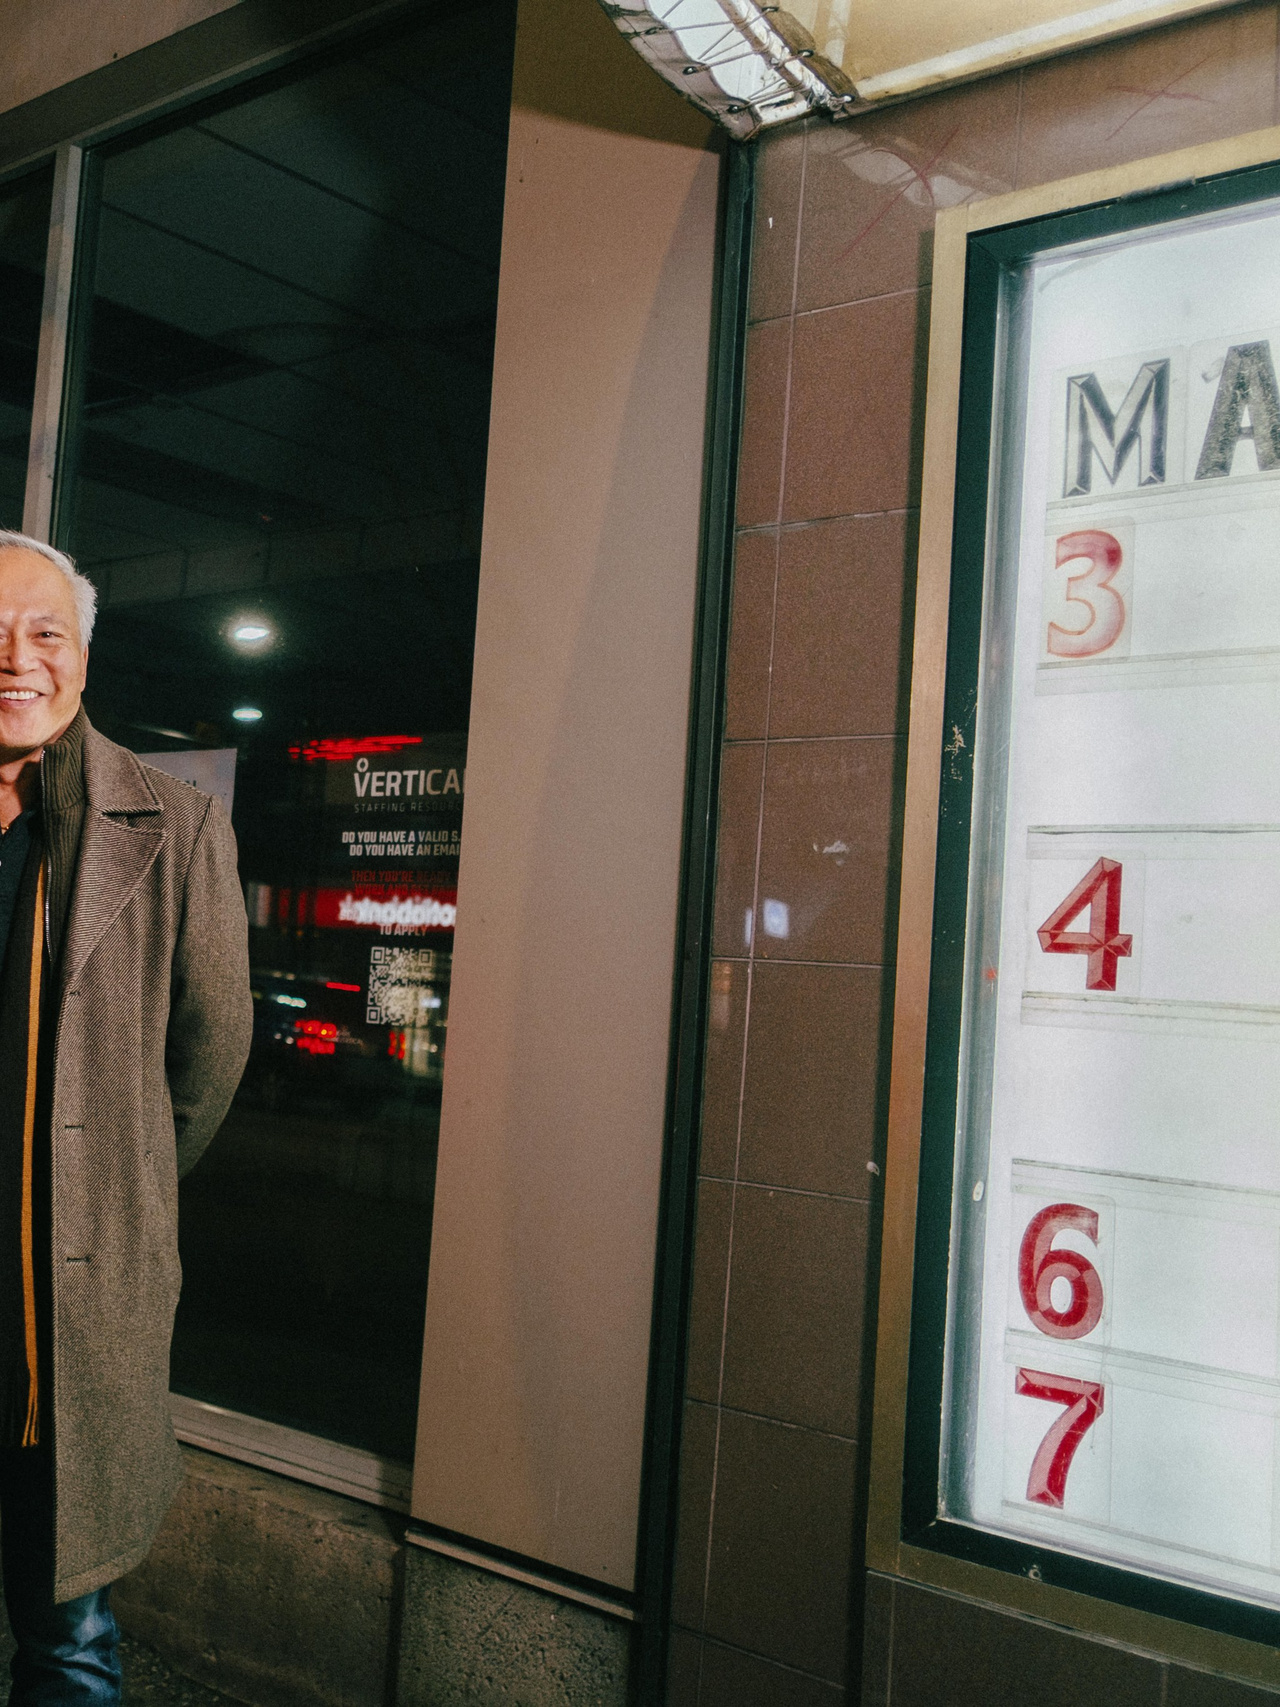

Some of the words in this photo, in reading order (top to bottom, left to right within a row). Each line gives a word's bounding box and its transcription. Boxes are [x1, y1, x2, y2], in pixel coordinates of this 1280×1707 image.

[1062, 339, 1280, 498] MA
[1047, 529, 1125, 658] 3
[354, 767, 466, 797] VERTICA
[354, 803, 405, 813] STAFFING
[410, 801, 460, 812] RESOURC
[342, 832, 353, 843] DO
[357, 832, 377, 843] YOU
[379, 831, 407, 843] HAVE
[407, 831, 416, 842] A
[418, 831, 448, 842] VALID
[451, 831, 461, 842] S.
[349, 845, 362, 856] DO
[365, 845, 385, 856] YOU
[387, 844, 414, 856] HAVE
[417, 844, 431, 855] AN
[433, 844, 461, 855] EMAI
[351, 870, 376, 882] THEN
[378, 870, 414, 882] YOU'RE
[380, 924, 392, 936] TO
[394, 923, 428, 936] APPLY
[1037, 856, 1132, 991] 4
[1017, 1203, 1104, 1340] 6
[1015, 1366, 1105, 1508] 7
